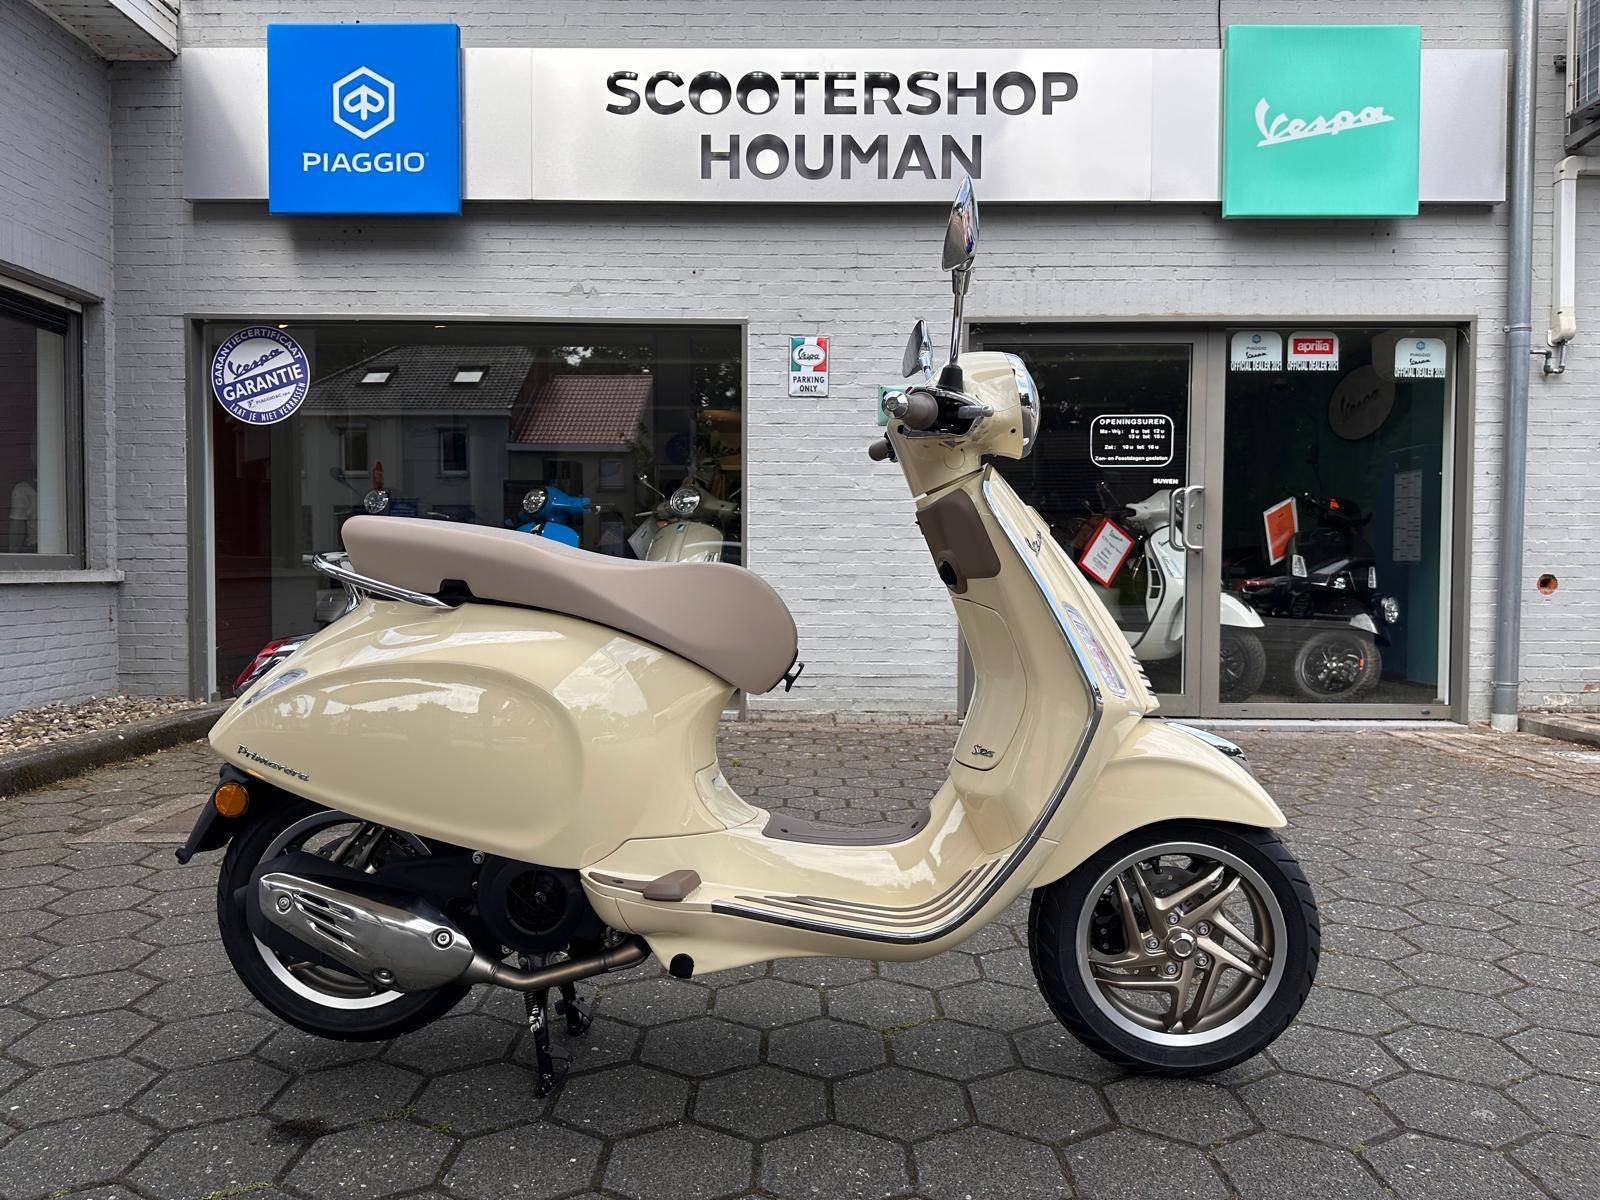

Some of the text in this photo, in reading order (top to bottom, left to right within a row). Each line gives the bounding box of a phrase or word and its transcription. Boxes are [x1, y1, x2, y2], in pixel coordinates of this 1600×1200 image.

[605, 70, 1079, 115] SCOOTERSHOP
[1254, 97, 1395, 148] Vespa
[302, 151, 426, 173] PIAGGIO
[700, 134, 982, 180] HOUMAN
[215, 328, 303, 386] GARANTIECERTIFICAAT
[797, 348, 820, 361] Vespa
[1297, 340, 1330, 353] aprilia
[227, 348, 284, 380] Vespa
[1231, 360, 1251, 371] OFFICIAL
[1252, 360, 1270, 371] DEALER
[1287, 360, 1308, 371] OFFICIAL
[1309, 360, 1327, 371] DEALER
[1394, 368, 1415, 378] OFFICIAL
[1416, 368, 1433, 378] DEALER
[223, 364, 303, 401] GARANTIE
[229, 382, 306, 422] LAAT JE NIET VERRASSEN
[237, 743, 310, 782] Primavera
